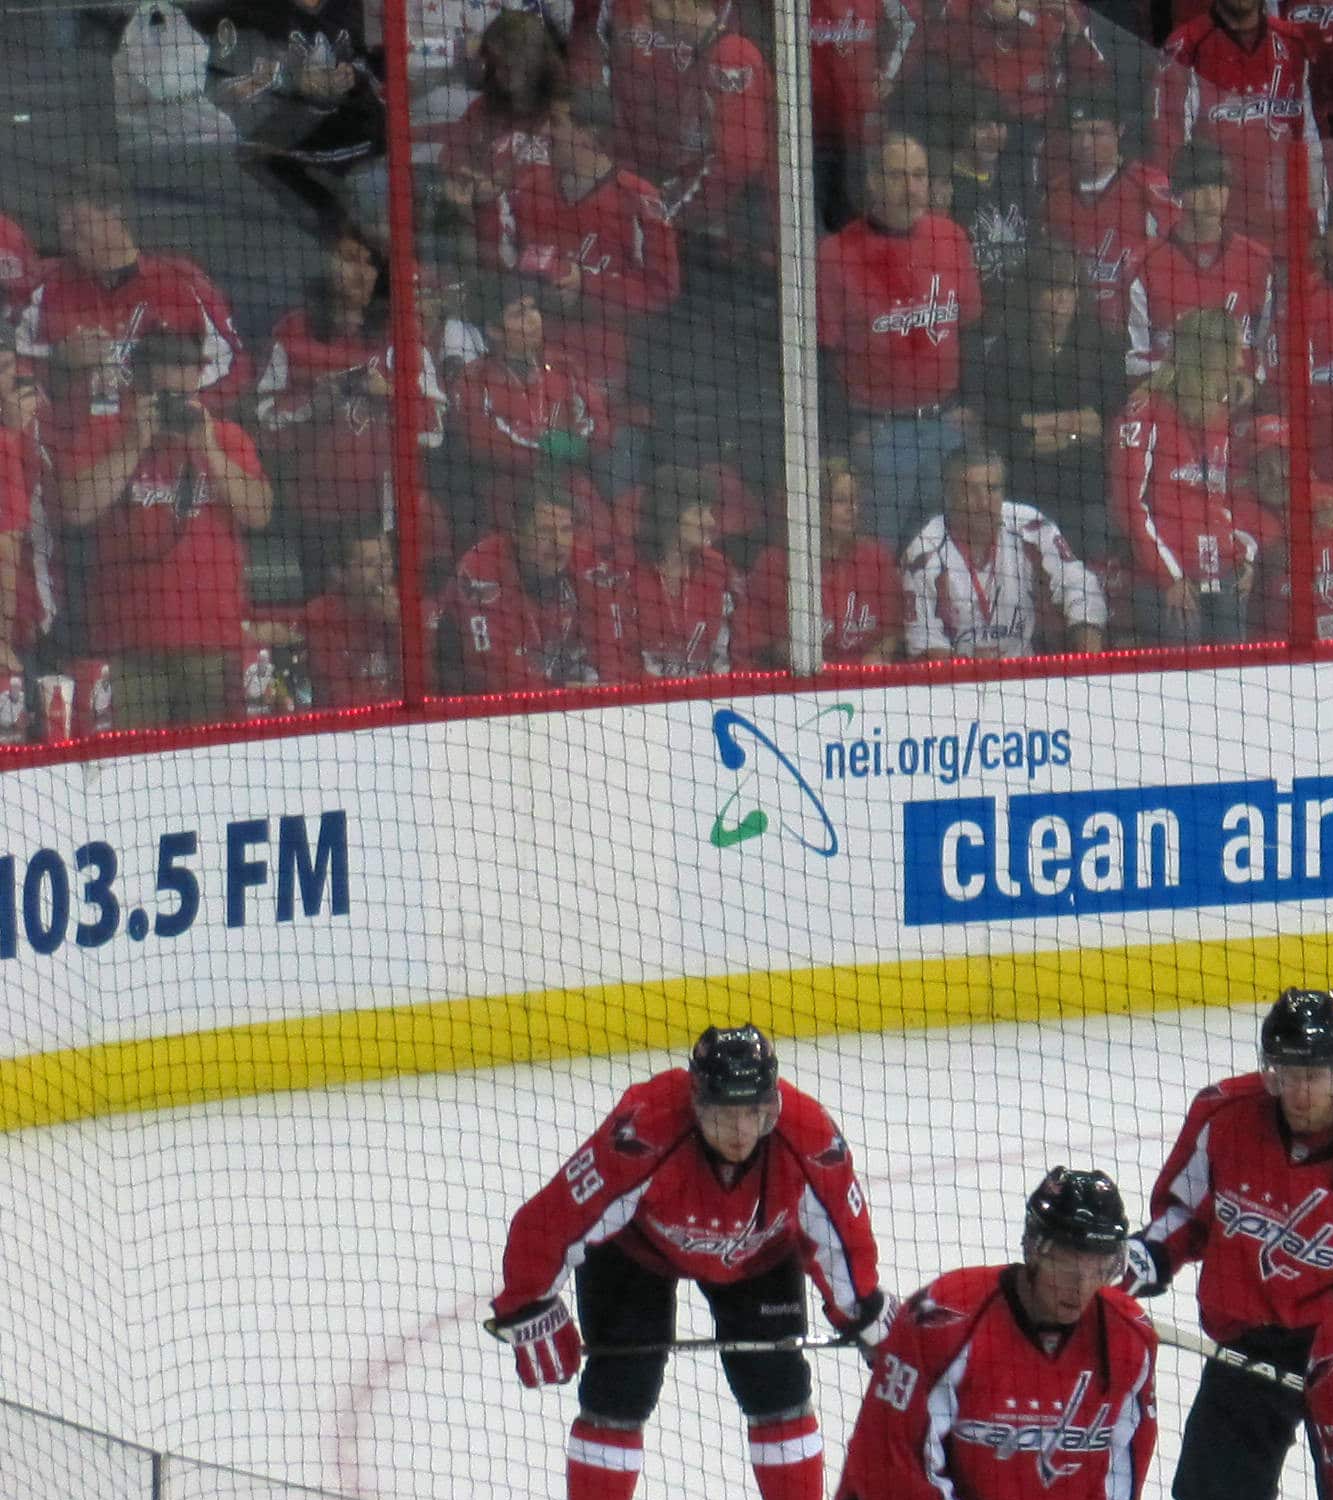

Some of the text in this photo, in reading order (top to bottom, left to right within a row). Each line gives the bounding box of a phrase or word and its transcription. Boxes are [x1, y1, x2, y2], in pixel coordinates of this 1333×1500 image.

[823, 719, 1072, 785] nei.org/caps
[226, 810, 351, 929] FM
[941, 788, 1182, 904] clean
